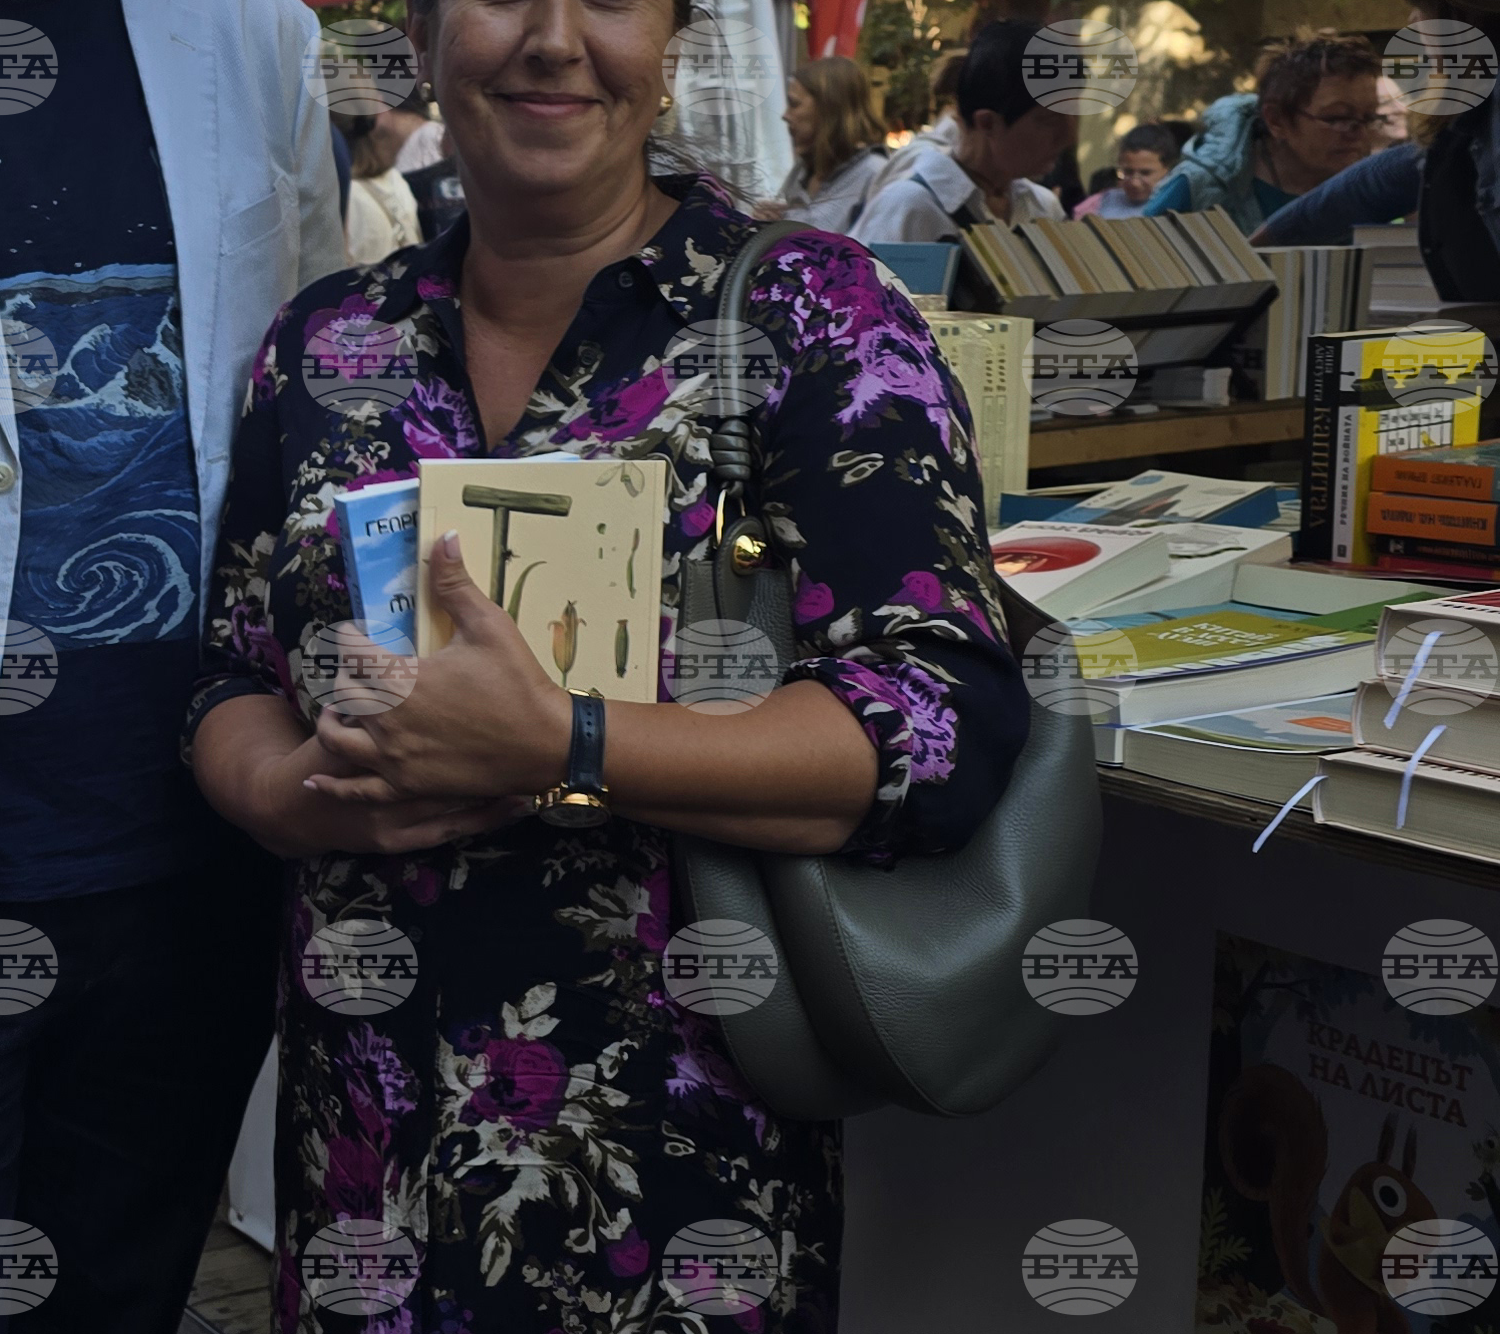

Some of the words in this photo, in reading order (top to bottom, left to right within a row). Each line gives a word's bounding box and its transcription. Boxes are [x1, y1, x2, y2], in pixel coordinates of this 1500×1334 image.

[1306, 1020, 1473, 1093] КРАДЕЦЪТ
[1307, 1052, 1353, 1091] НА
[1358, 1071, 1468, 1128] ЛИСТА
